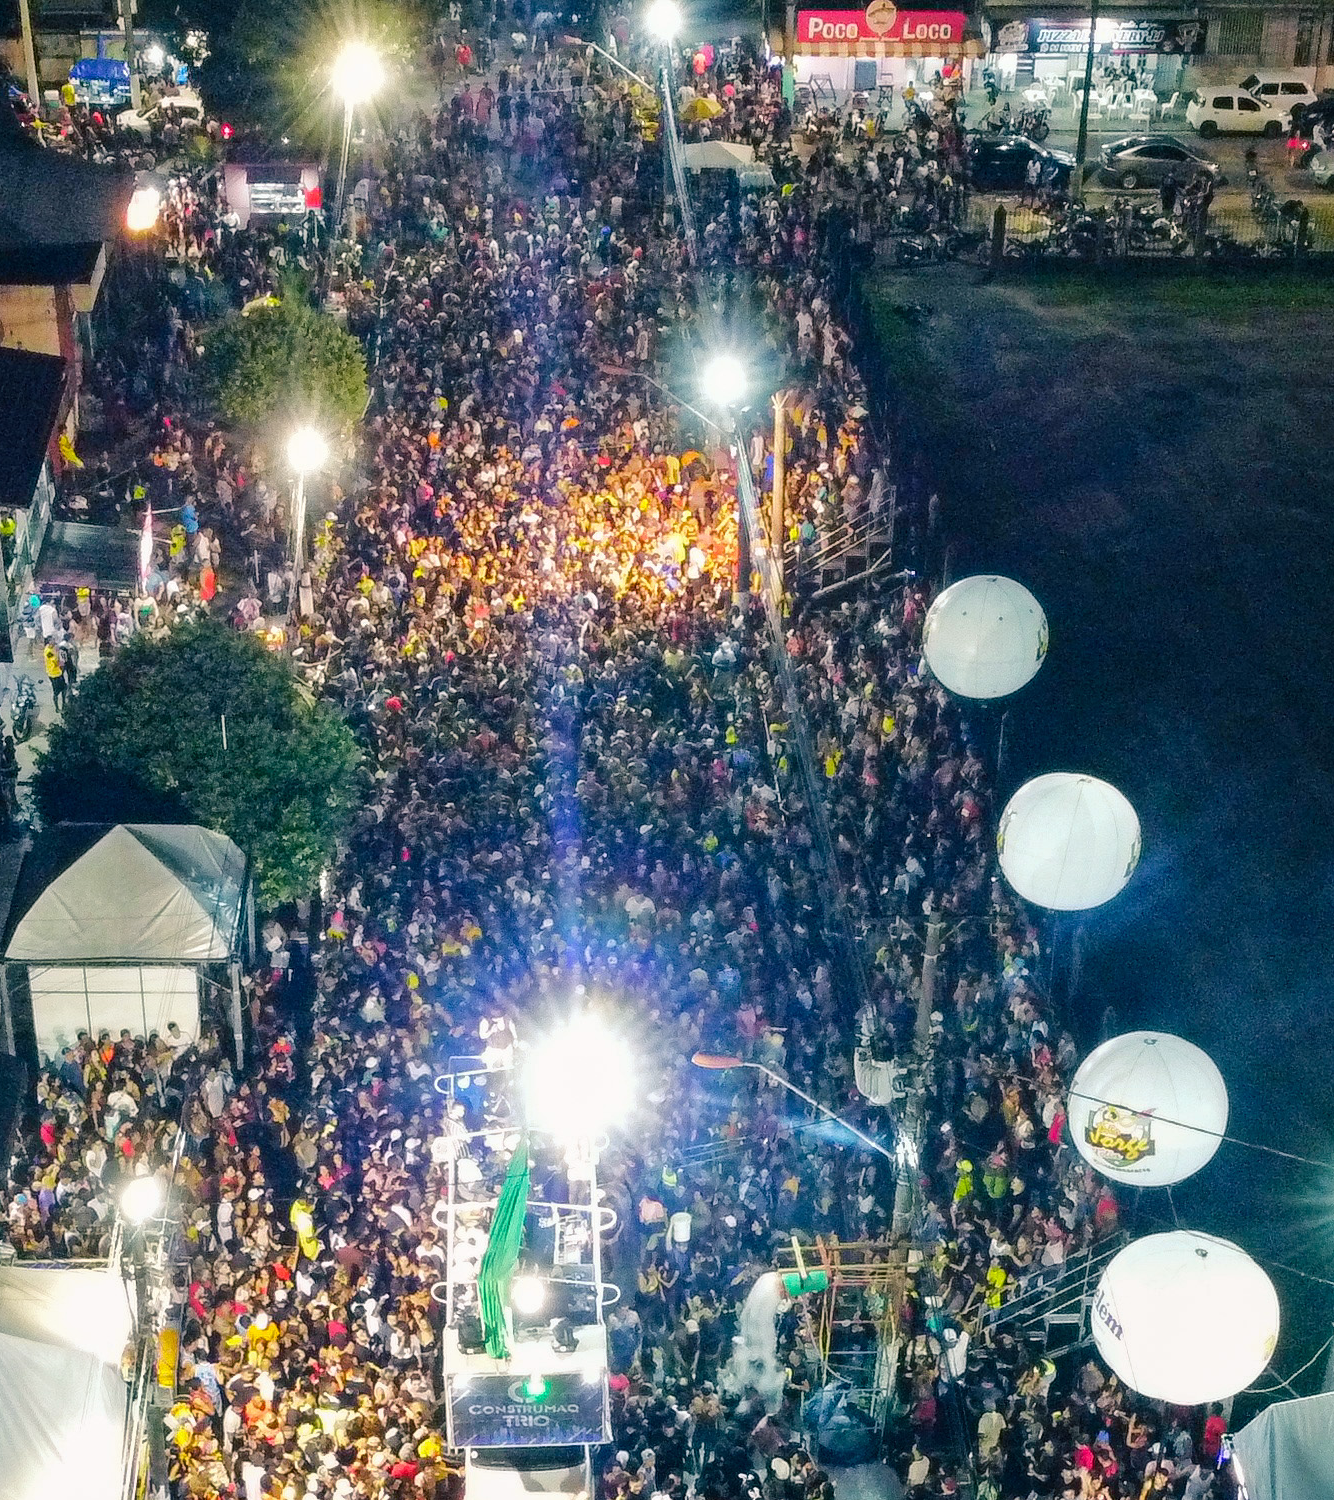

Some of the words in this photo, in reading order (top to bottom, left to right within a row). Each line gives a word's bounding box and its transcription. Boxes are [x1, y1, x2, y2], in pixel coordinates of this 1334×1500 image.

[808, 17, 858, 39] Poco
[903, 18, 952, 39] Loco
[468, 1404, 579, 1415] CONSTRUMAQ
[502, 1415, 551, 1427] TRIO
